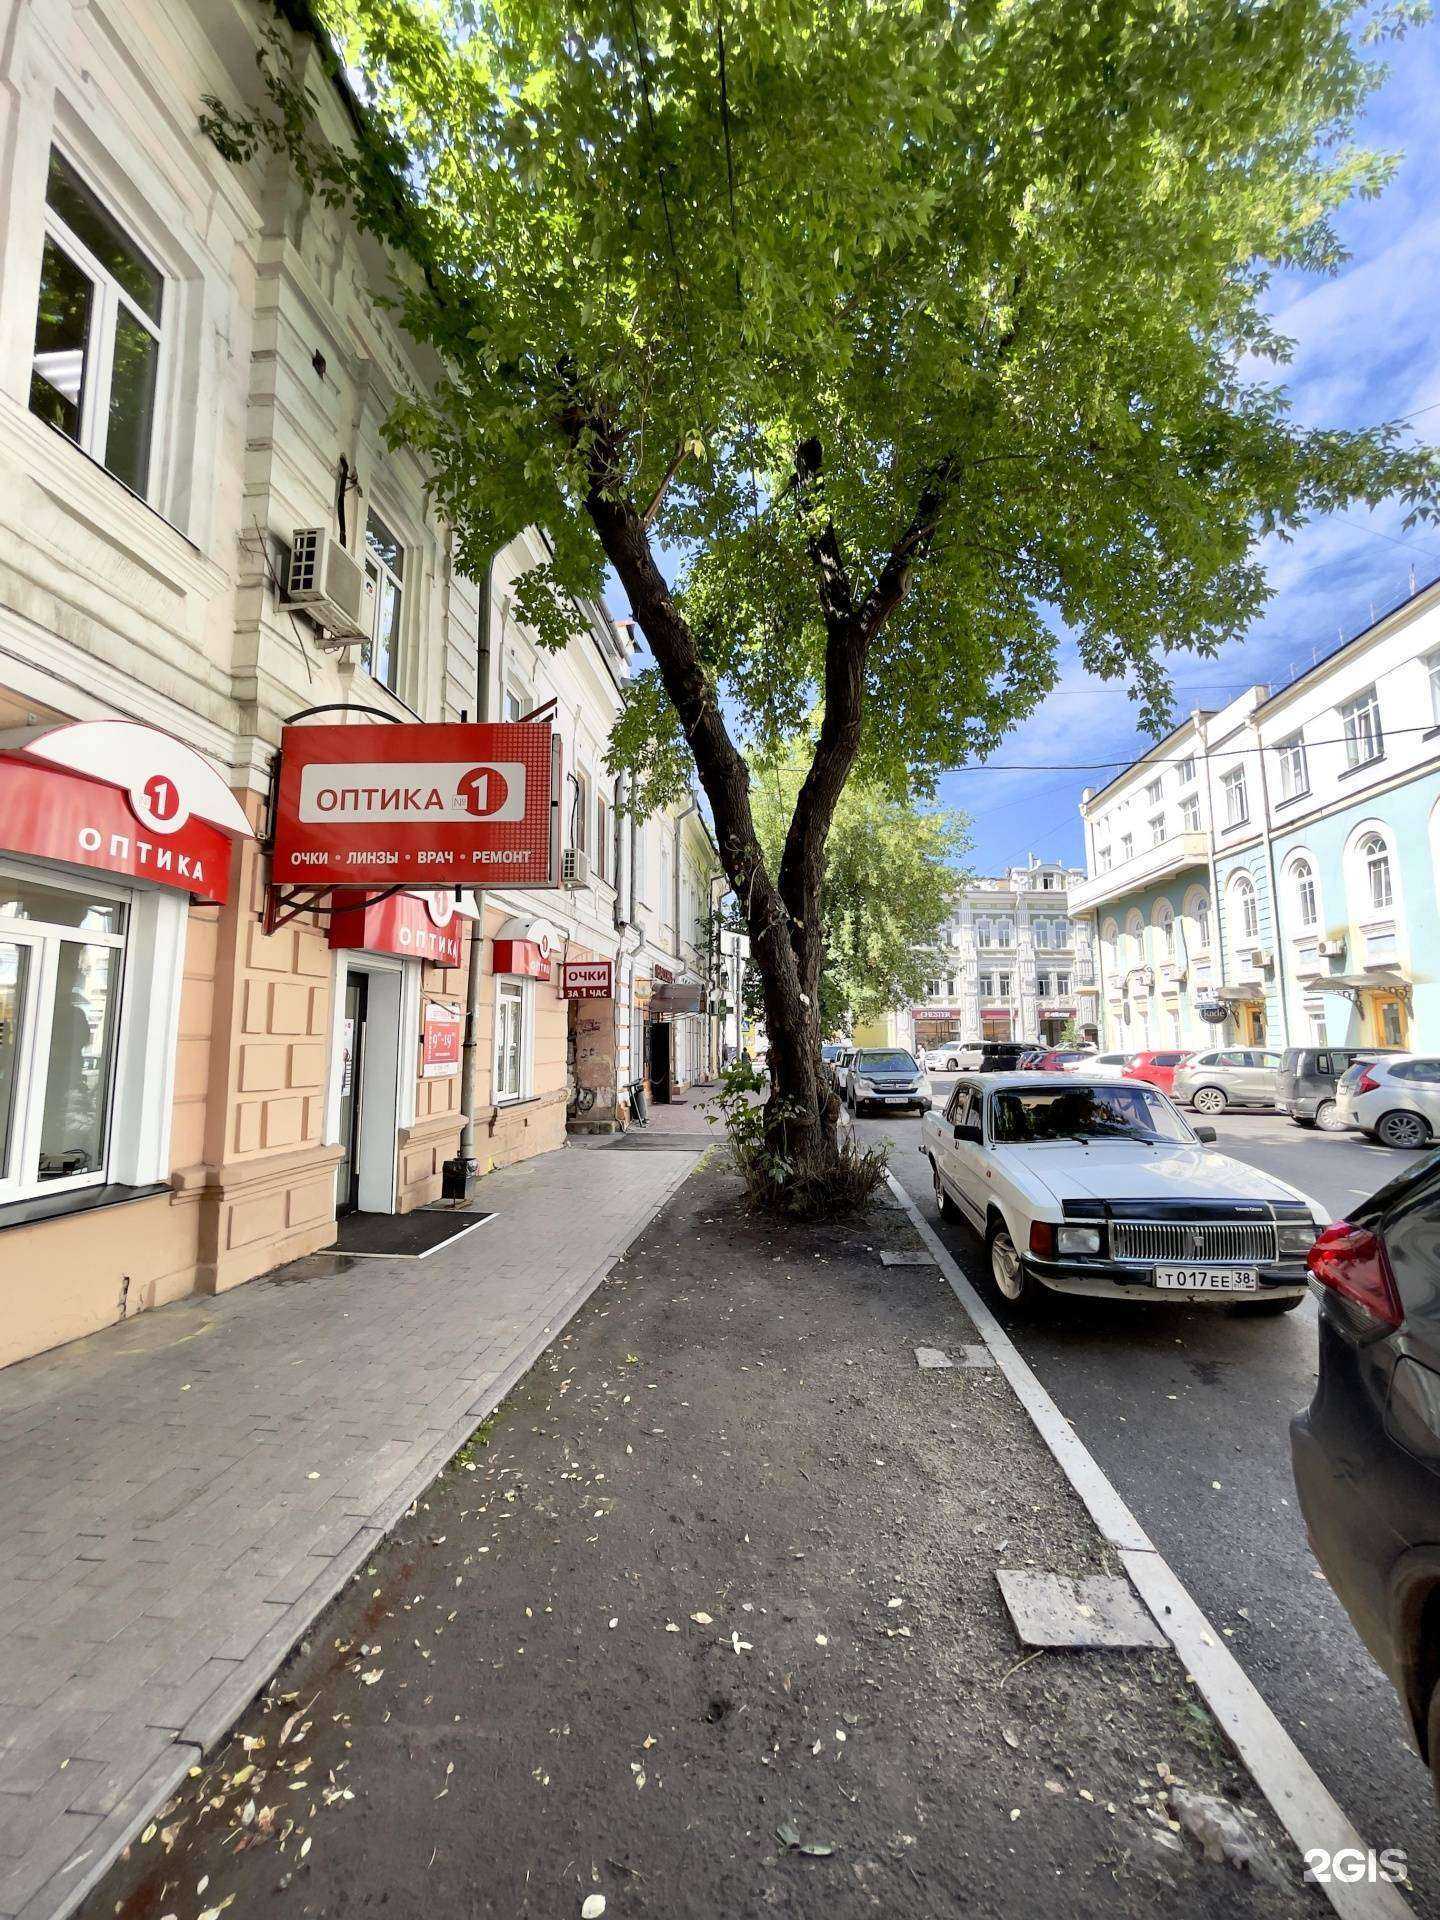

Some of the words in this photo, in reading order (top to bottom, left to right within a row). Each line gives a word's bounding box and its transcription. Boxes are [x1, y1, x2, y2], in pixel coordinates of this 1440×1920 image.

[316, 788, 444, 812] ОПТИКА
[78, 827, 204, 881] ОПТИКА
[291, 852, 328, 865] ОЧКИ
[346, 851, 398, 864] ЛИНЗЫ
[417, 851, 453, 864] ВРАЧ
[472, 850, 531, 864] РЕМОНТ
[399, 926, 458, 959] ОПТИКА
[568, 971, 606, 981] ОЧКИ
[581, 987, 587, 997] 1
[589, 989, 608, 997] ЧАС
[1235, 1272, 1250, 1284] 38
